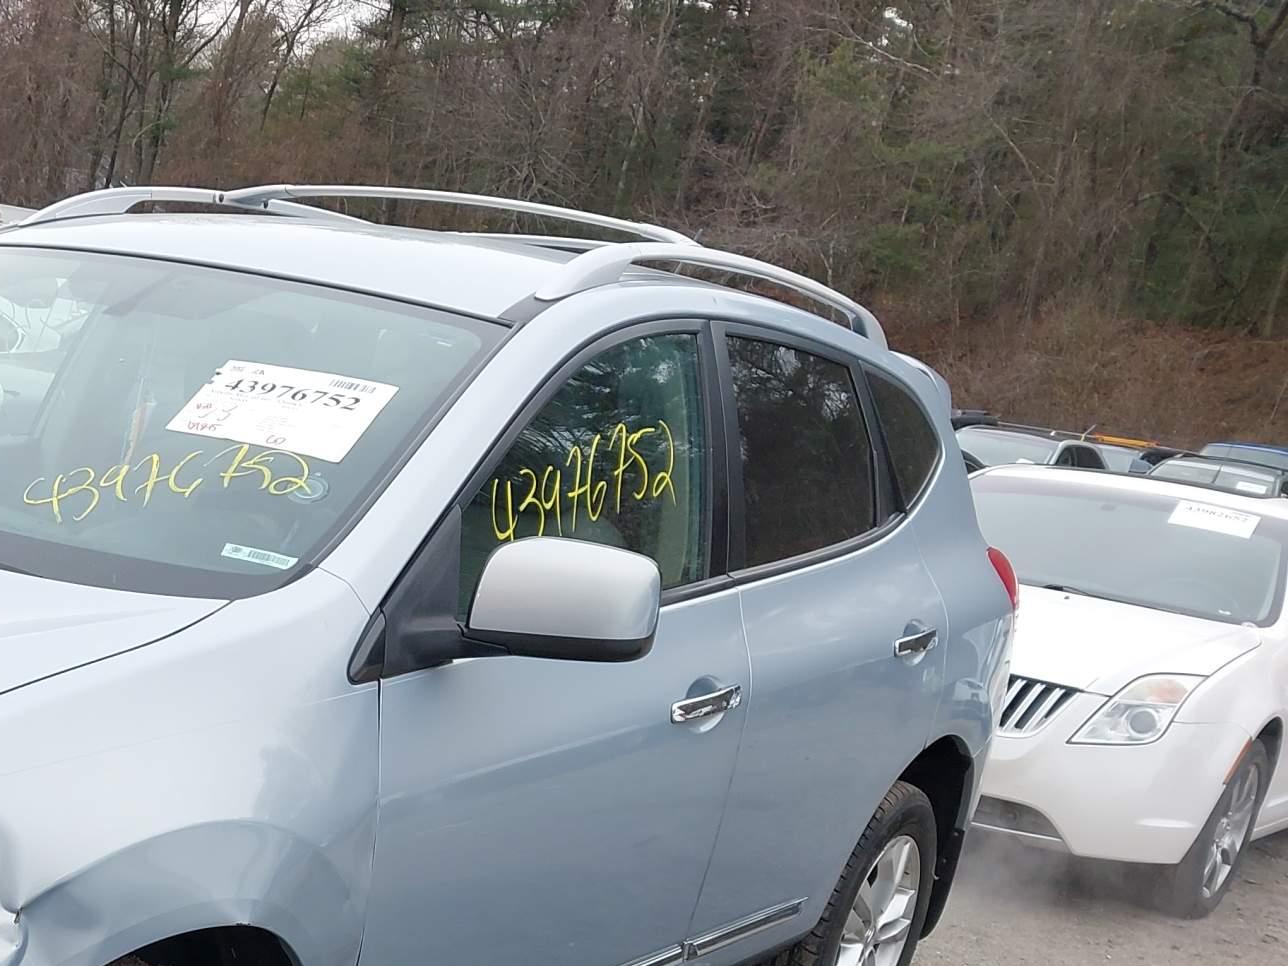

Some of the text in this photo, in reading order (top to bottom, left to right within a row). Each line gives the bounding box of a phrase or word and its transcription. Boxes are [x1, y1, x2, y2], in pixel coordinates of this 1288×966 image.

[224, 378, 362, 411] 43976752
[23, 444, 312, 524] 43976752
[492, 419, 677, 541] 43976752
